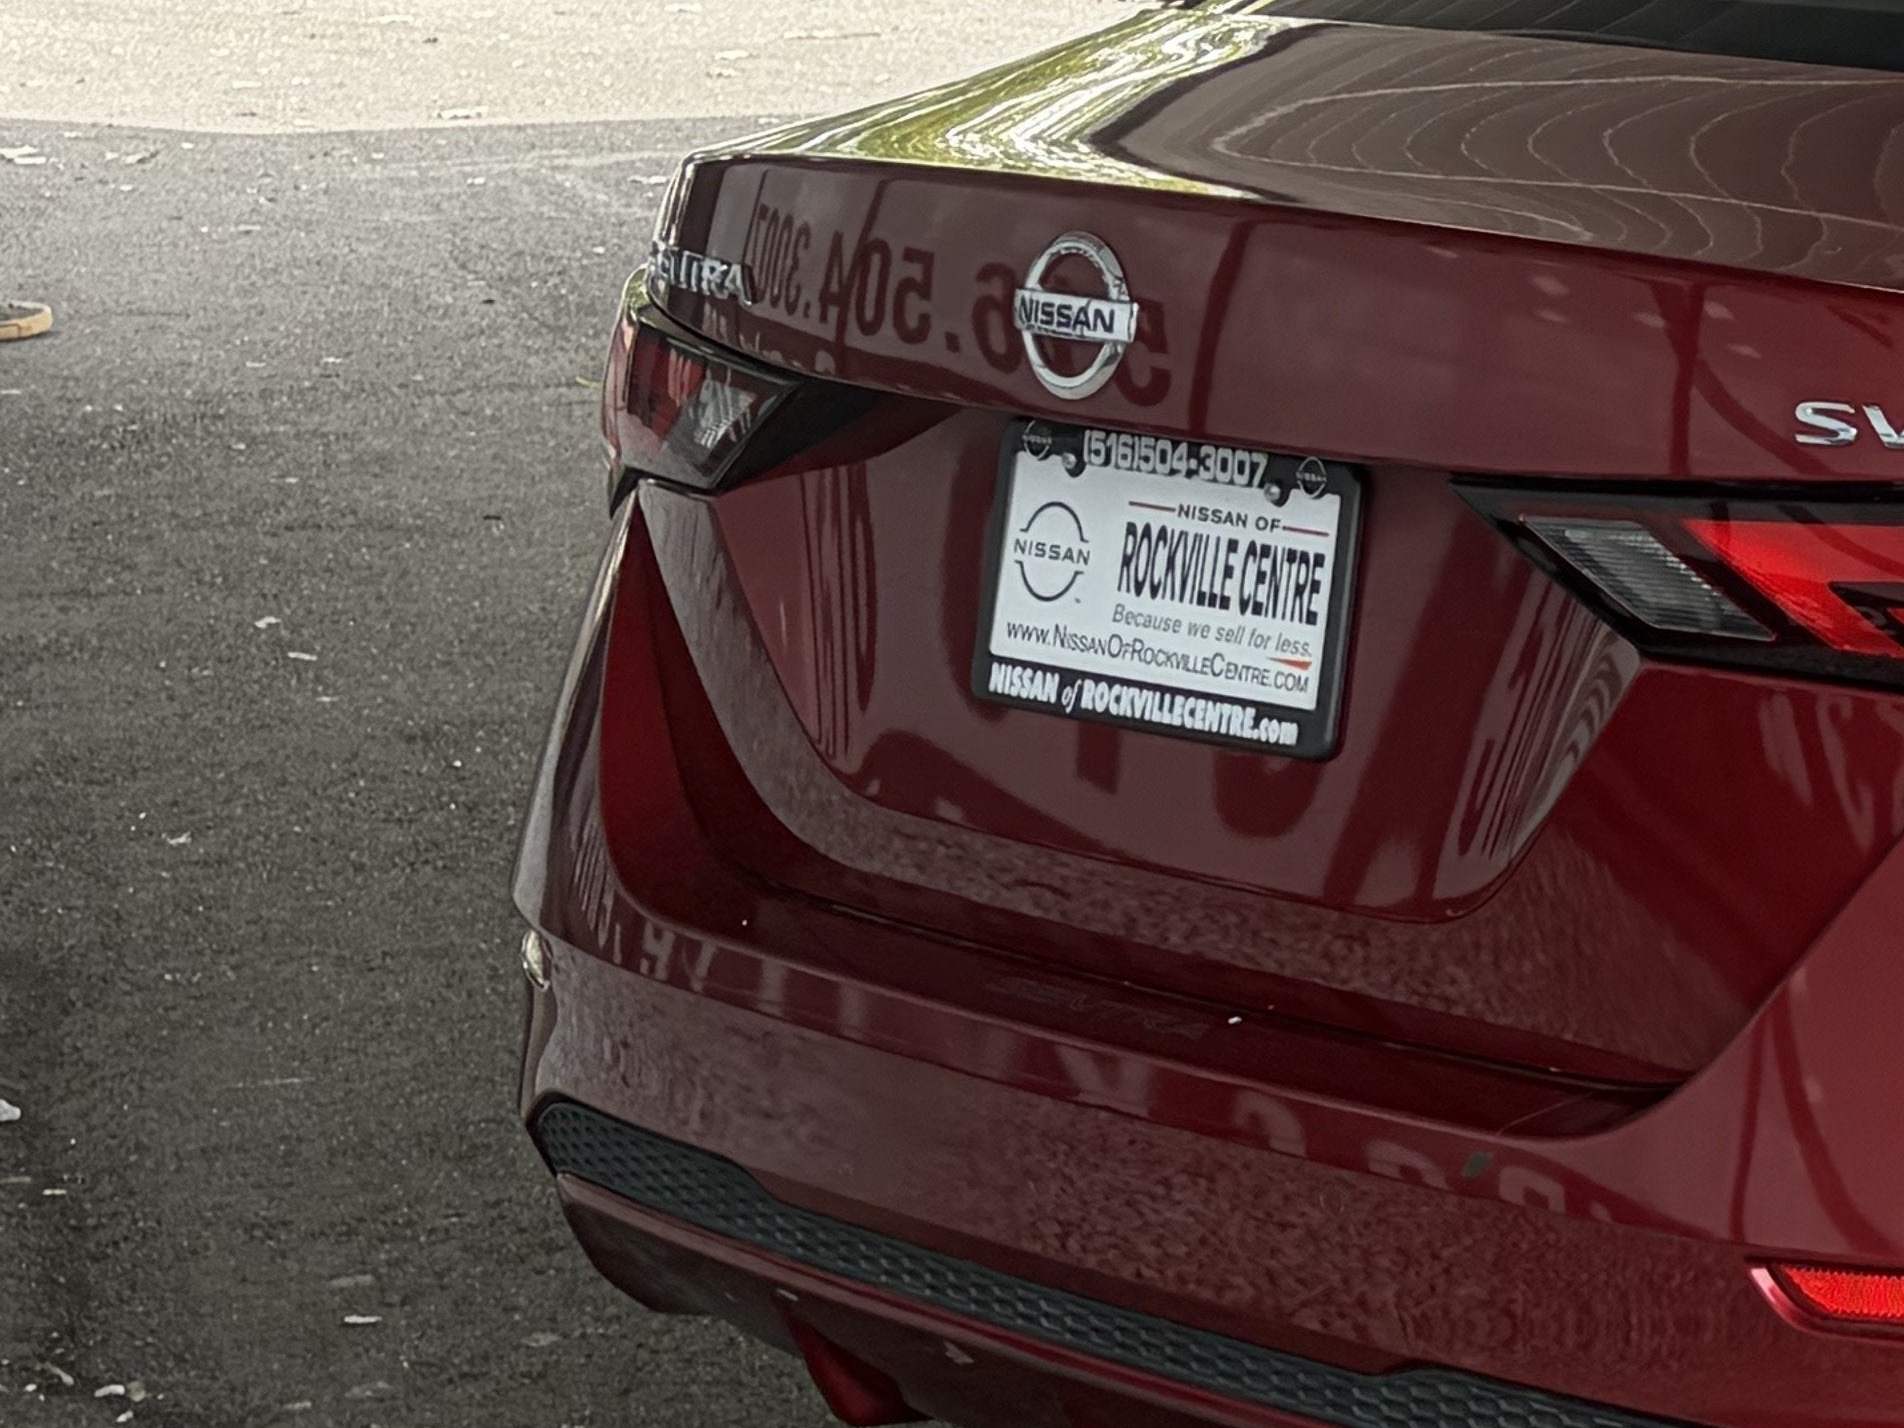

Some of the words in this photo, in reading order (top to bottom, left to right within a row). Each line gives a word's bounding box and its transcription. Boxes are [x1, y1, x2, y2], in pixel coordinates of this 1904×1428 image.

[1018, 294, 1116, 334] NISSAN
[1177, 503, 1249, 528] NISSAN
[1255, 516, 1281, 533] OF
[1014, 537, 1091, 566] NISSAN
[1117, 521, 1239, 611] ROCKVILLE
[1239, 539, 1326, 626] CENTRE
[1112, 603, 1182, 633] Because
[1187, 622, 1210, 639] we
[1215, 624, 1246, 646] sell
[1250, 628, 1272, 652] for
[1275, 632, 1312, 657] less.
[989, 662, 1060, 704] NISSAN
[1061, 679, 1082, 713] of
[1080, 679, 1299, 746] ROCKVILLECENTRE.com
